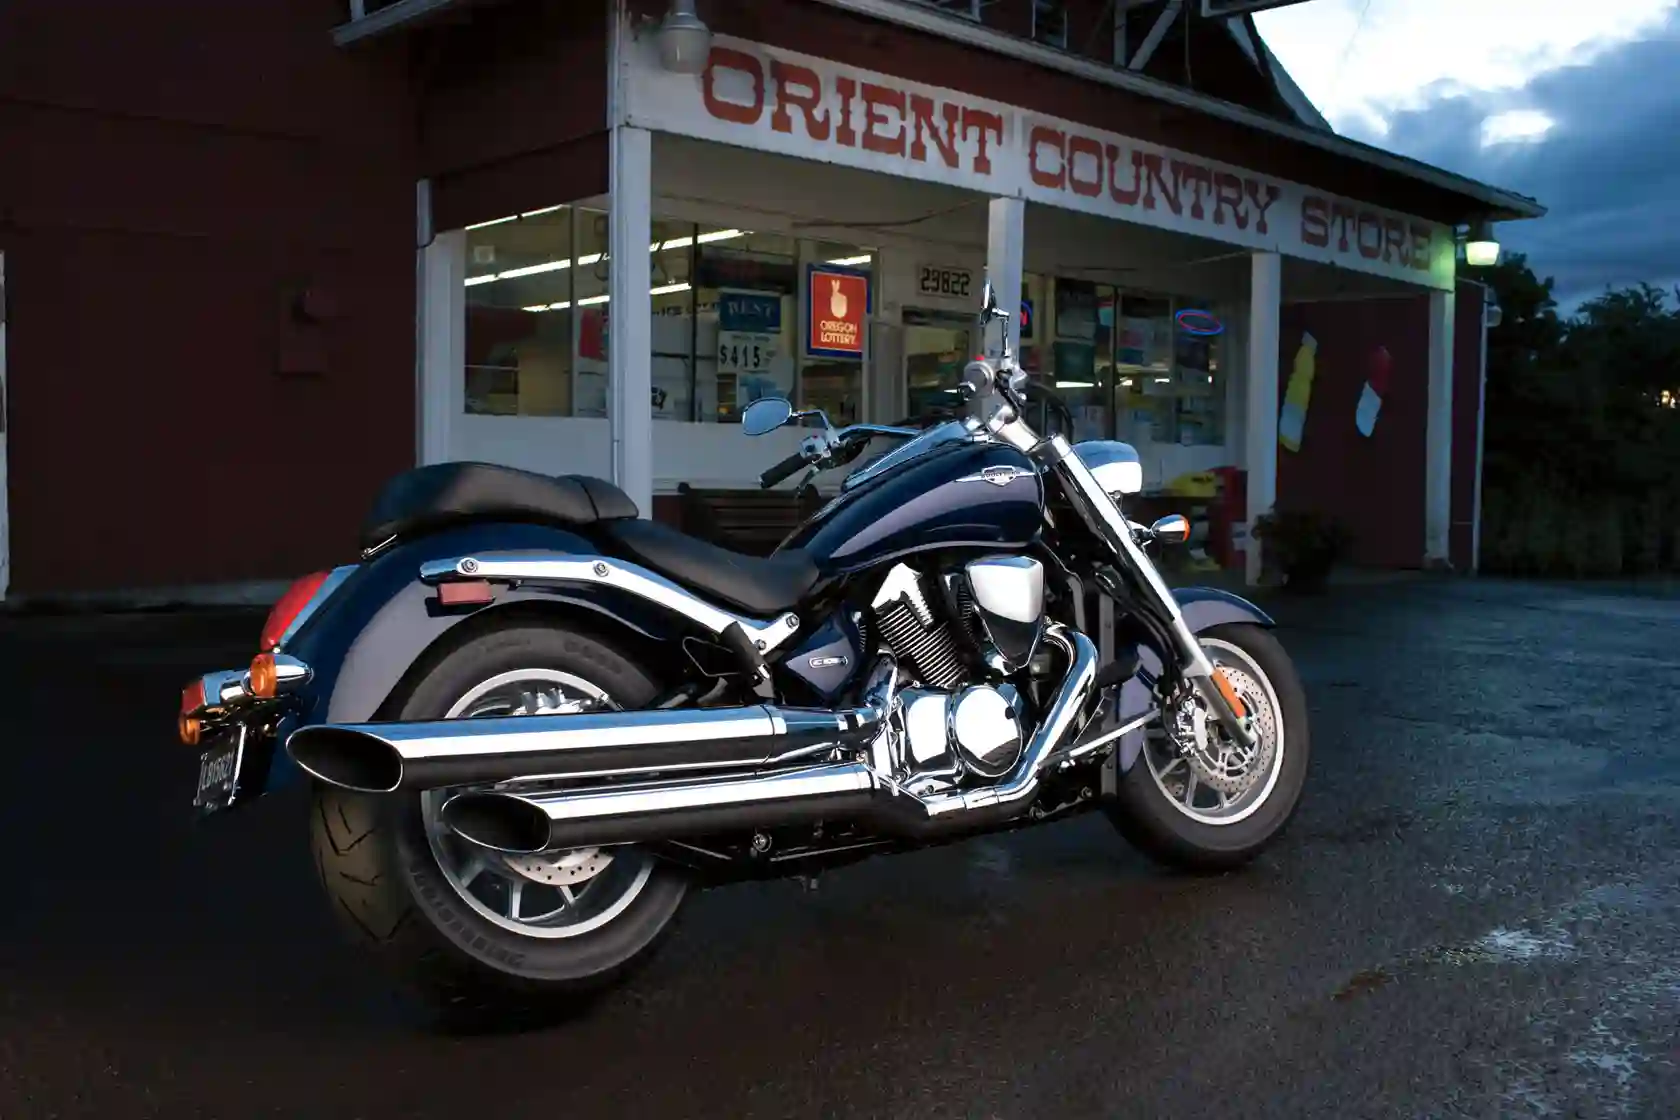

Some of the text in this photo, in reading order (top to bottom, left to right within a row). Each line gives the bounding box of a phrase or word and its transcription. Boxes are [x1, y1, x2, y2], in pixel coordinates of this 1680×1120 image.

[703, 46, 1431, 271] ORIENT COUNTRY STORE
[921, 267, 971, 295] 23822
[820, 320, 858, 334] OREGON
[820, 332, 857, 345] LOTTERY
